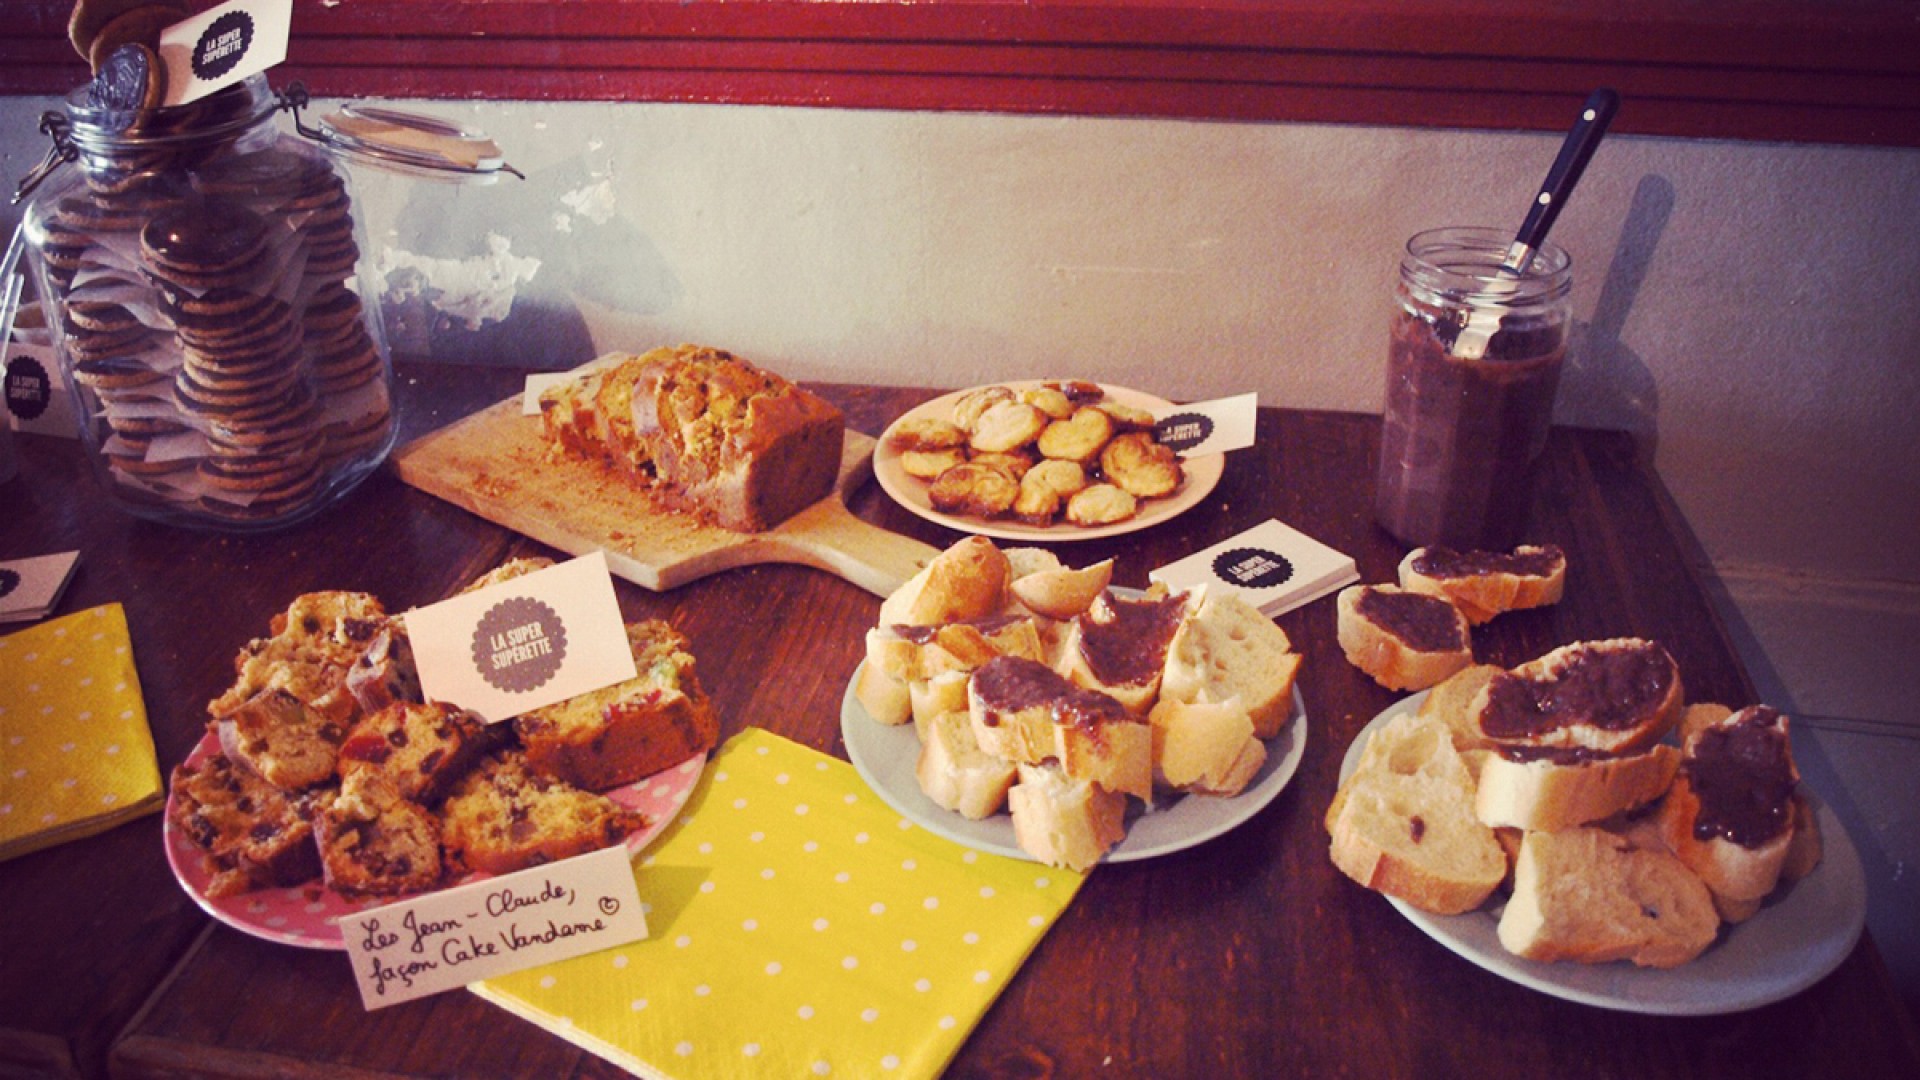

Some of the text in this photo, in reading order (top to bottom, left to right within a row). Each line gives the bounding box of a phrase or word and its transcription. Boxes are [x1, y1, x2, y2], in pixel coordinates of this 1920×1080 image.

[206, 27, 241, 51] LA SUPER
[1173, 422, 1201, 433] SUPER
[1227, 555, 1266, 575] LA SUPER
[490, 621, 544, 651] LA SUPER
[361, 918, 399, 951] Les
[370, 919, 607, 996] façon Cake Vandame
